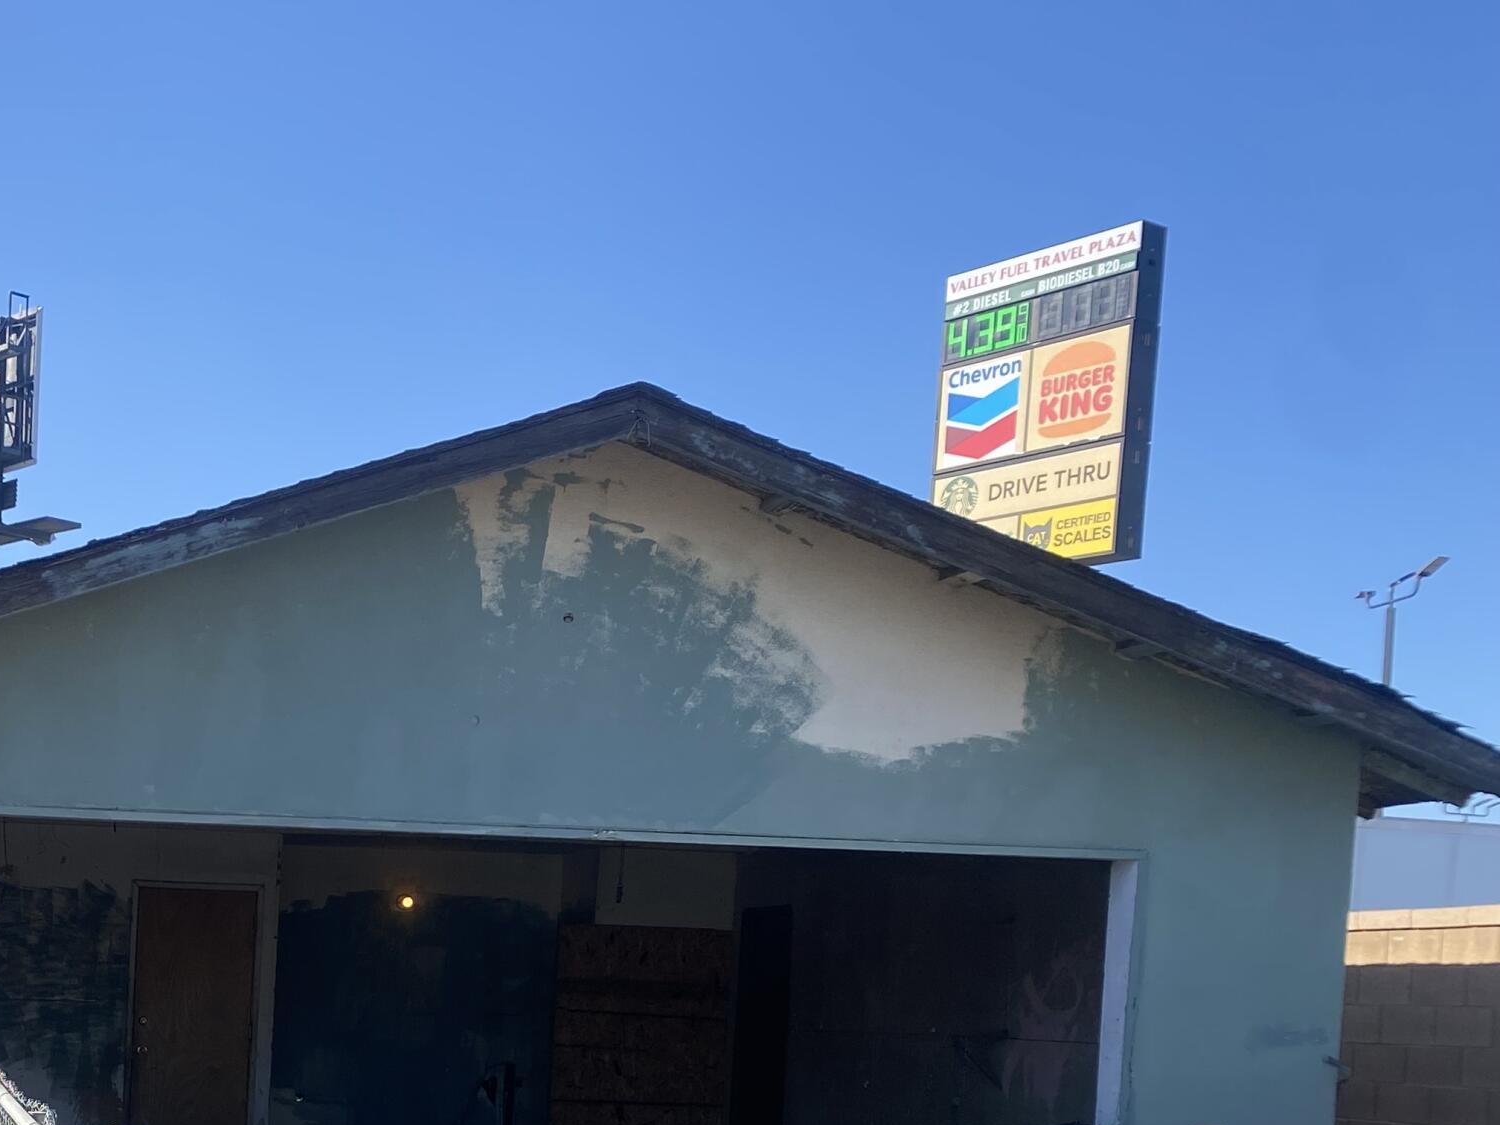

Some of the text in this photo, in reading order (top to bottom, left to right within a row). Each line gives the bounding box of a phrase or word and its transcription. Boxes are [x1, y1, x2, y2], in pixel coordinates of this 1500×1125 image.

[951, 231, 1136, 294] VALLEY FUEL TRAVEL PLAZA
[1038, 266, 1094, 294] BIODIESEL
[1098, 259, 1120, 276] B20
[953, 302, 970, 316] #2
[973, 291, 1011, 311] DIESEL
[949, 360, 1022, 389] Chevron
[1041, 365, 1115, 398] BURGER
[1038, 385, 1113, 425] KING
[988, 461, 1111, 502] DRIVE THRU
[1053, 526, 1111, 547] SCALES
[1056, 512, 1111, 530] CERTIFIED
